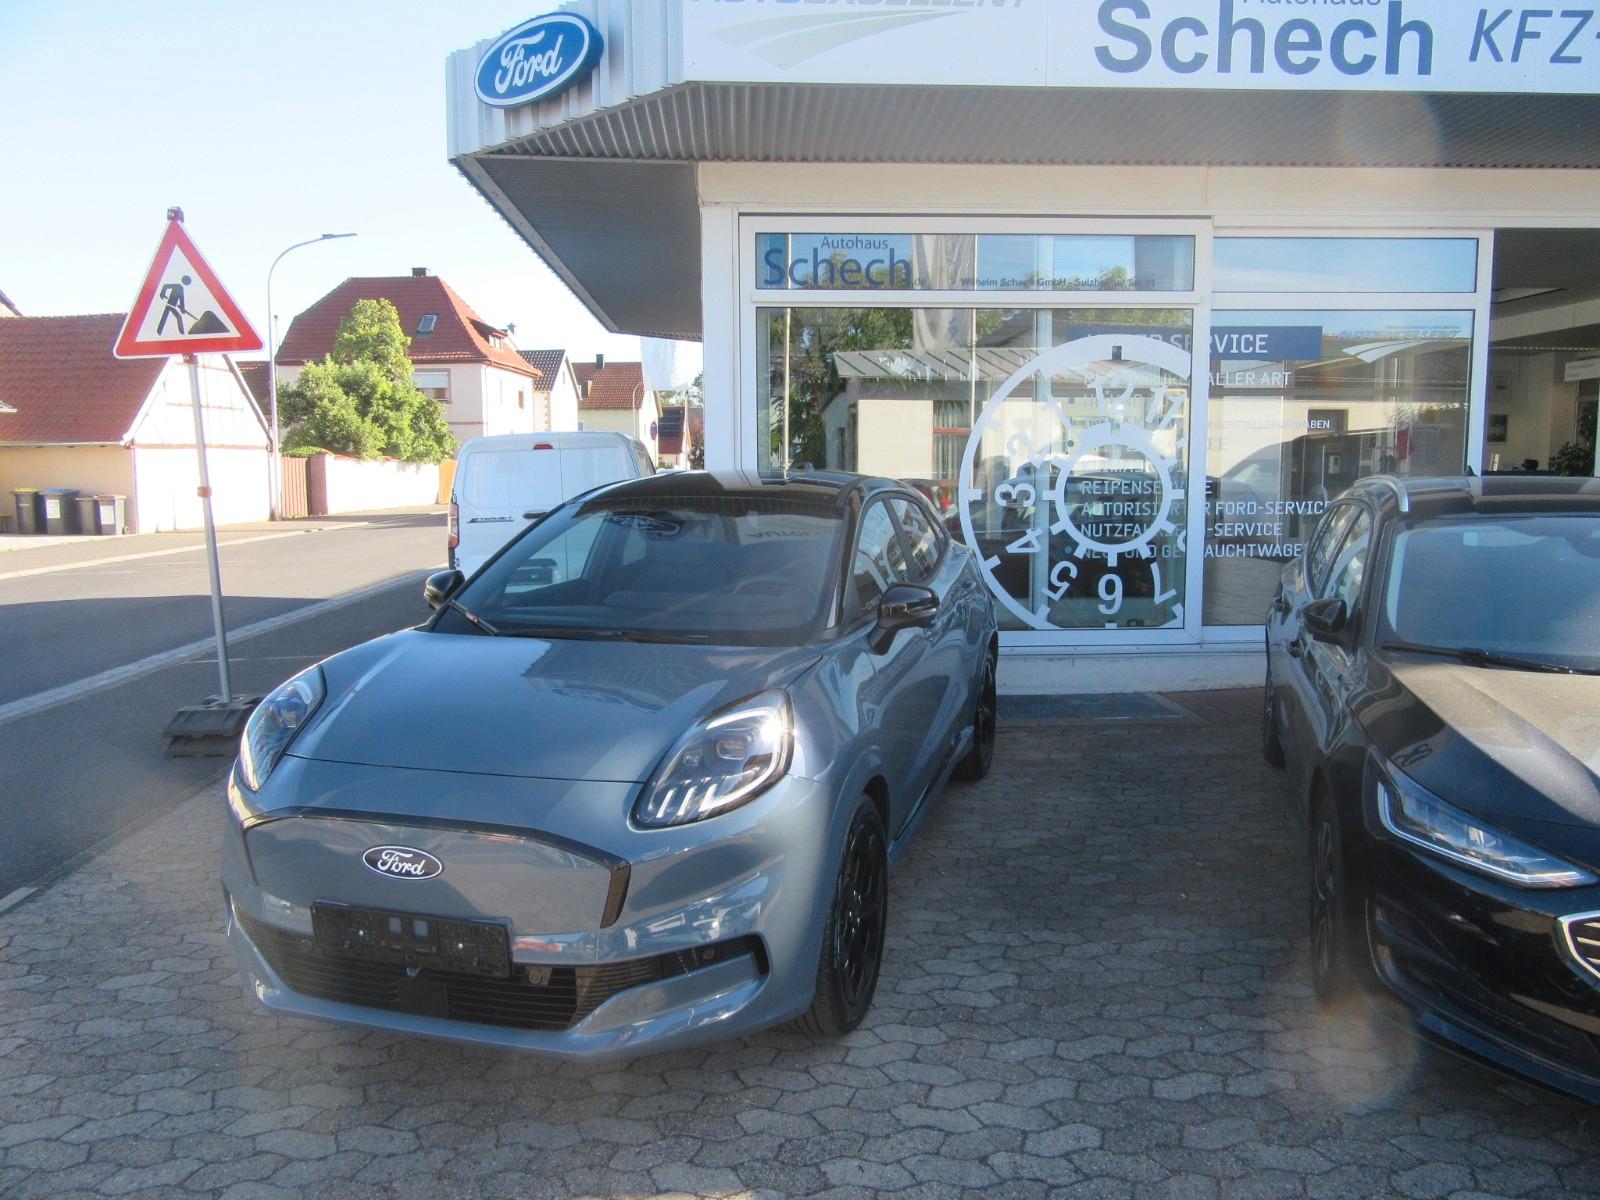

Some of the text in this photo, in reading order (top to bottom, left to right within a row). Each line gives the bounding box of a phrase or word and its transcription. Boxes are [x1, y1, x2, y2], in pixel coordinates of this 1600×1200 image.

[1094, 0, 1600, 75] Schech KFZ
[494, 30, 564, 94] Ford
[821, 236, 888, 250] Autohaus
[763, 248, 914, 286] Schech
[1261, 371, 1292, 386] ART
[994, 483, 1036, 508] 3
[1005, 527, 1043, 554] 4
[377, 849, 426, 876] Ford
